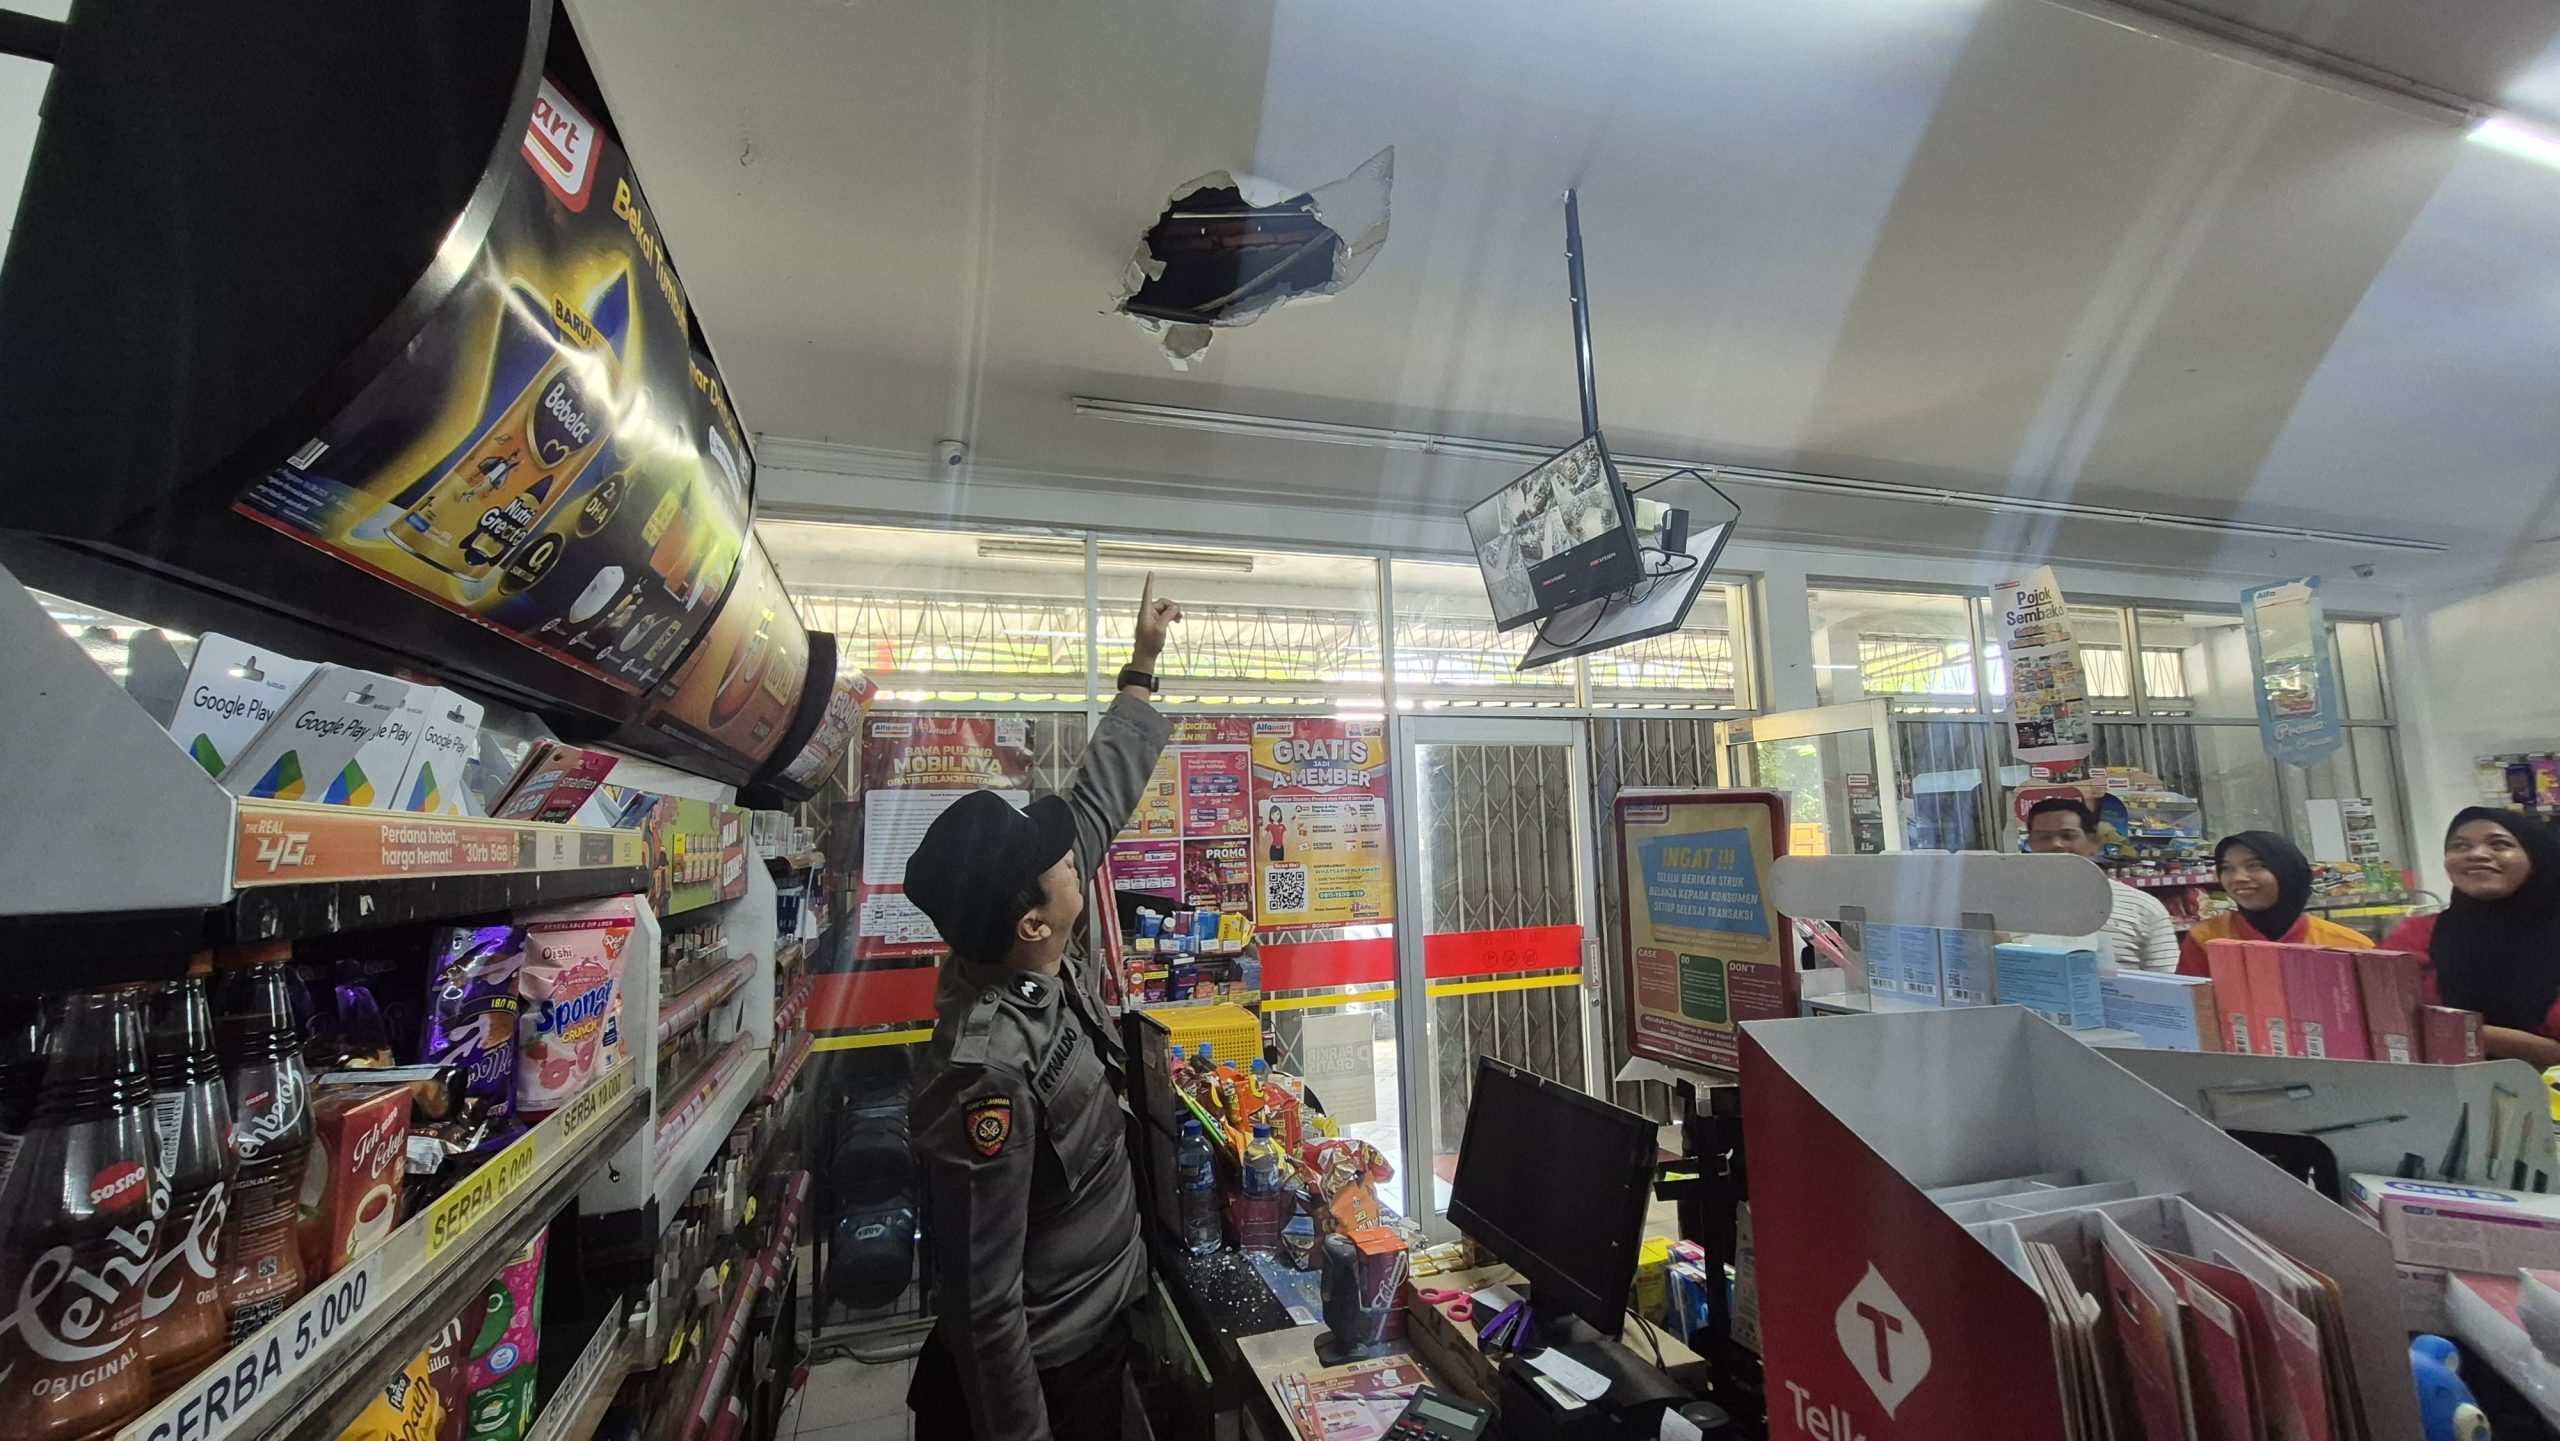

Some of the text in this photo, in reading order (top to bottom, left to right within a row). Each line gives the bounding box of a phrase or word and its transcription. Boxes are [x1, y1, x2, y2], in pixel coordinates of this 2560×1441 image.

[611, 177, 653, 266] Bekal
[555, 298, 592, 346] BARU!
[544, 382, 590, 444] Bebelac
[504, 496, 538, 526] Nutri
[585, 498, 609, 525] DHA
[2016, 586, 2053, 607] Pojok
[2006, 604, 2065, 627] Sembako
[193, 685, 246, 720] Google
[295, 710, 372, 743] Google Play
[388, 722, 414, 747] Play
[875, 724, 910, 733] Alfamart
[1184, 722, 1218, 731] DIGITAL
[1256, 722, 1292, 731] Alfamart
[424, 725, 469, 757] Google Play
[905, 746, 994, 758] BAWA PULANG
[1272, 738, 1369, 764] GRATIS
[893, 756, 1003, 775] MOBILNYA
[1312, 760, 1331, 768] JADI
[887, 775, 922, 788] GRATIS
[921, 775, 965, 785] BELANJA
[257, 819, 284, 834] REAL
[381, 825, 460, 847] Perdana hebat,
[254, 832, 311, 873] 4G
[381, 846, 453, 871] harga hemat!
[1205, 847, 1246, 859] PROMO
[1663, 846, 1736, 870] INGAT !!!
[1681, 873, 1717, 885] BERIKAN
[1717, 875, 1745, 888] STRUK
[1648, 886, 1759, 905] BELANJA KEPADA KONSUMEN
[1653, 901, 1754, 921] SETIAP SELESAI TRANSAKSI
[541, 946, 573, 961] Oishi
[1638, 949, 1756, 974] CASE DO DON'T
[561, 1021, 599, 1044] CRUNCH
[1037, 1026, 1078, 1094] RYNALDO
[562, 1072, 622, 1137] SERBA 10.000
[351, 1122, 380, 1173] Teh
[371, 1127, 406, 1180] Celup
[89, 1165, 146, 1206] SOSRO
[2395, 1182, 2504, 1202] Oral-B
[432, 1146, 533, 1251] SERBA 6.000
[293, 1269, 368, 1362] 5.000
[31, 1346, 139, 1397] ORIGINAL
